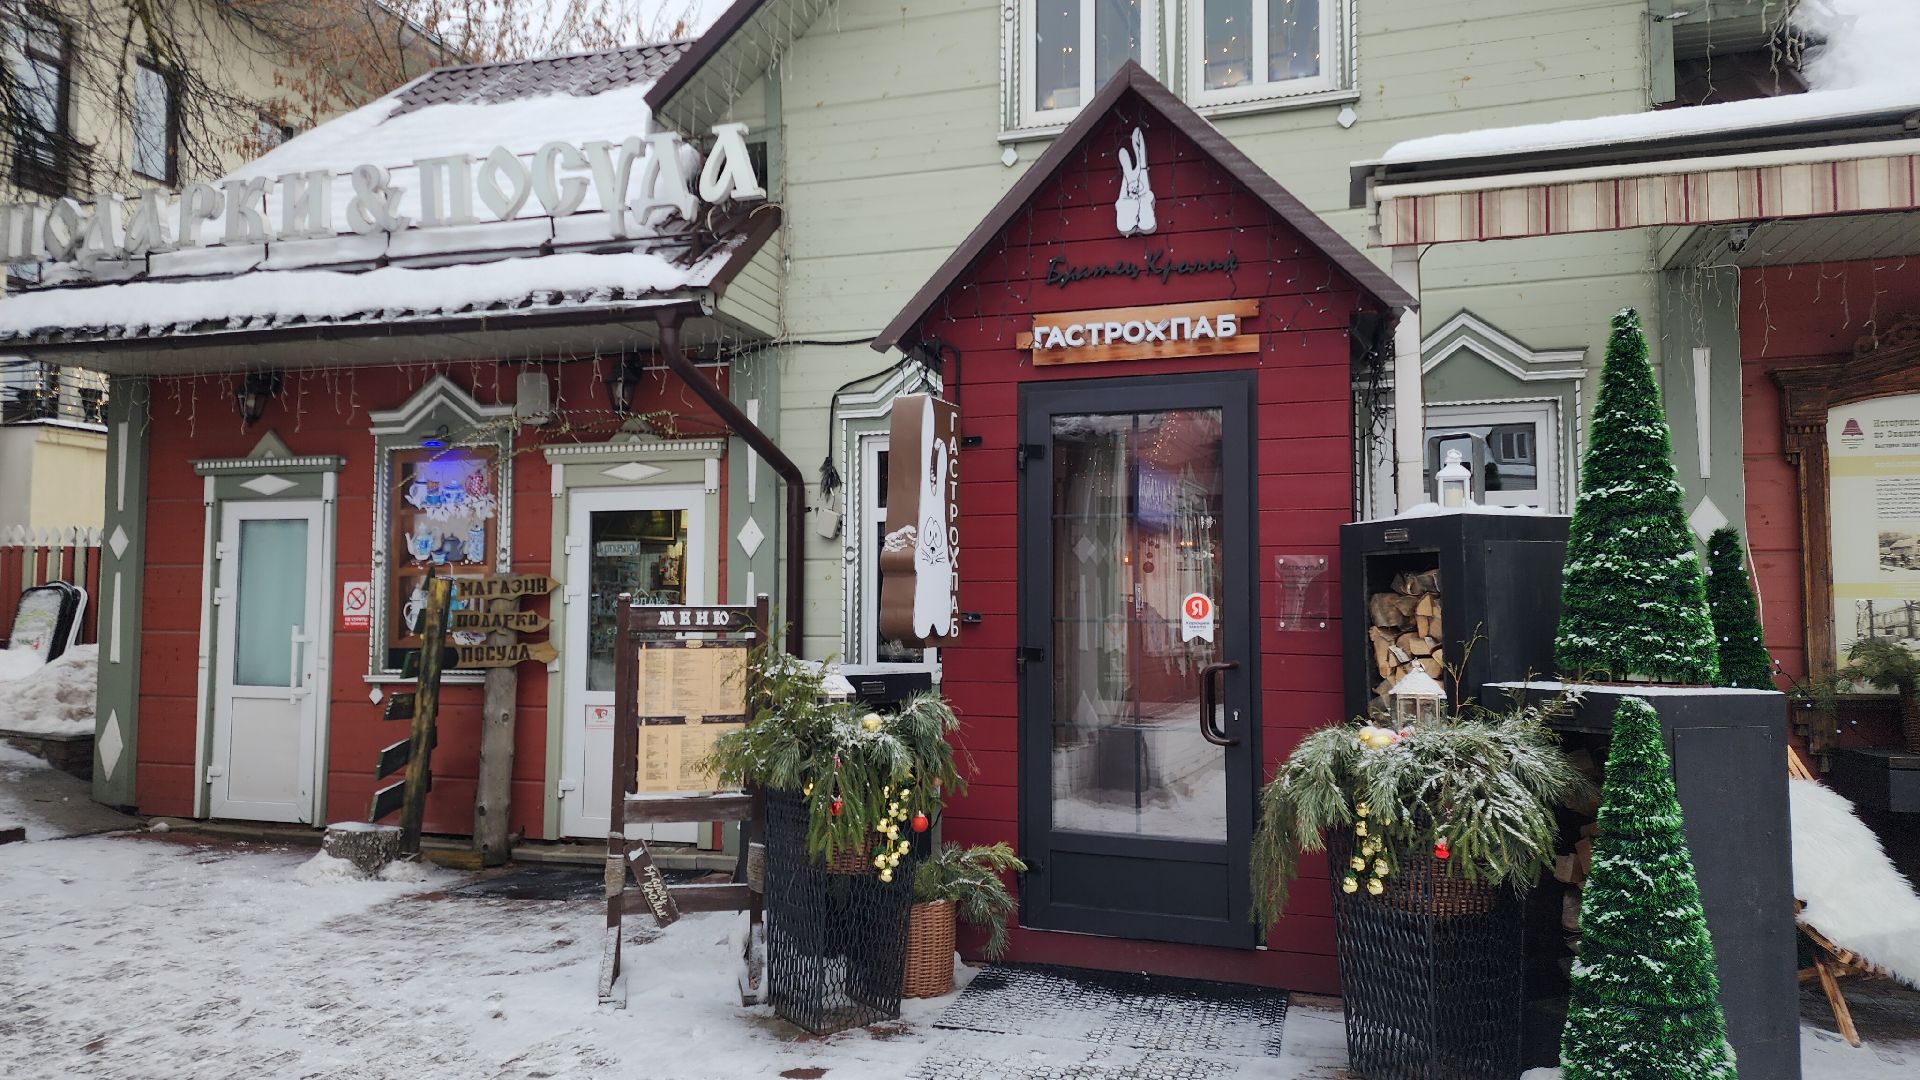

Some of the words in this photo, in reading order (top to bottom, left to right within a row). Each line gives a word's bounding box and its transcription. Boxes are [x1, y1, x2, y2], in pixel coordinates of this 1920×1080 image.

[413, 123, 766, 239] ПОСУДА
[1034, 313, 1237, 349] ГАСТРОХПАБ
[460, 578, 547, 596] МАГАЗИН
[456, 614, 538, 629] ПОДАРКИ
[461, 645, 531, 662] ПОСУДА
